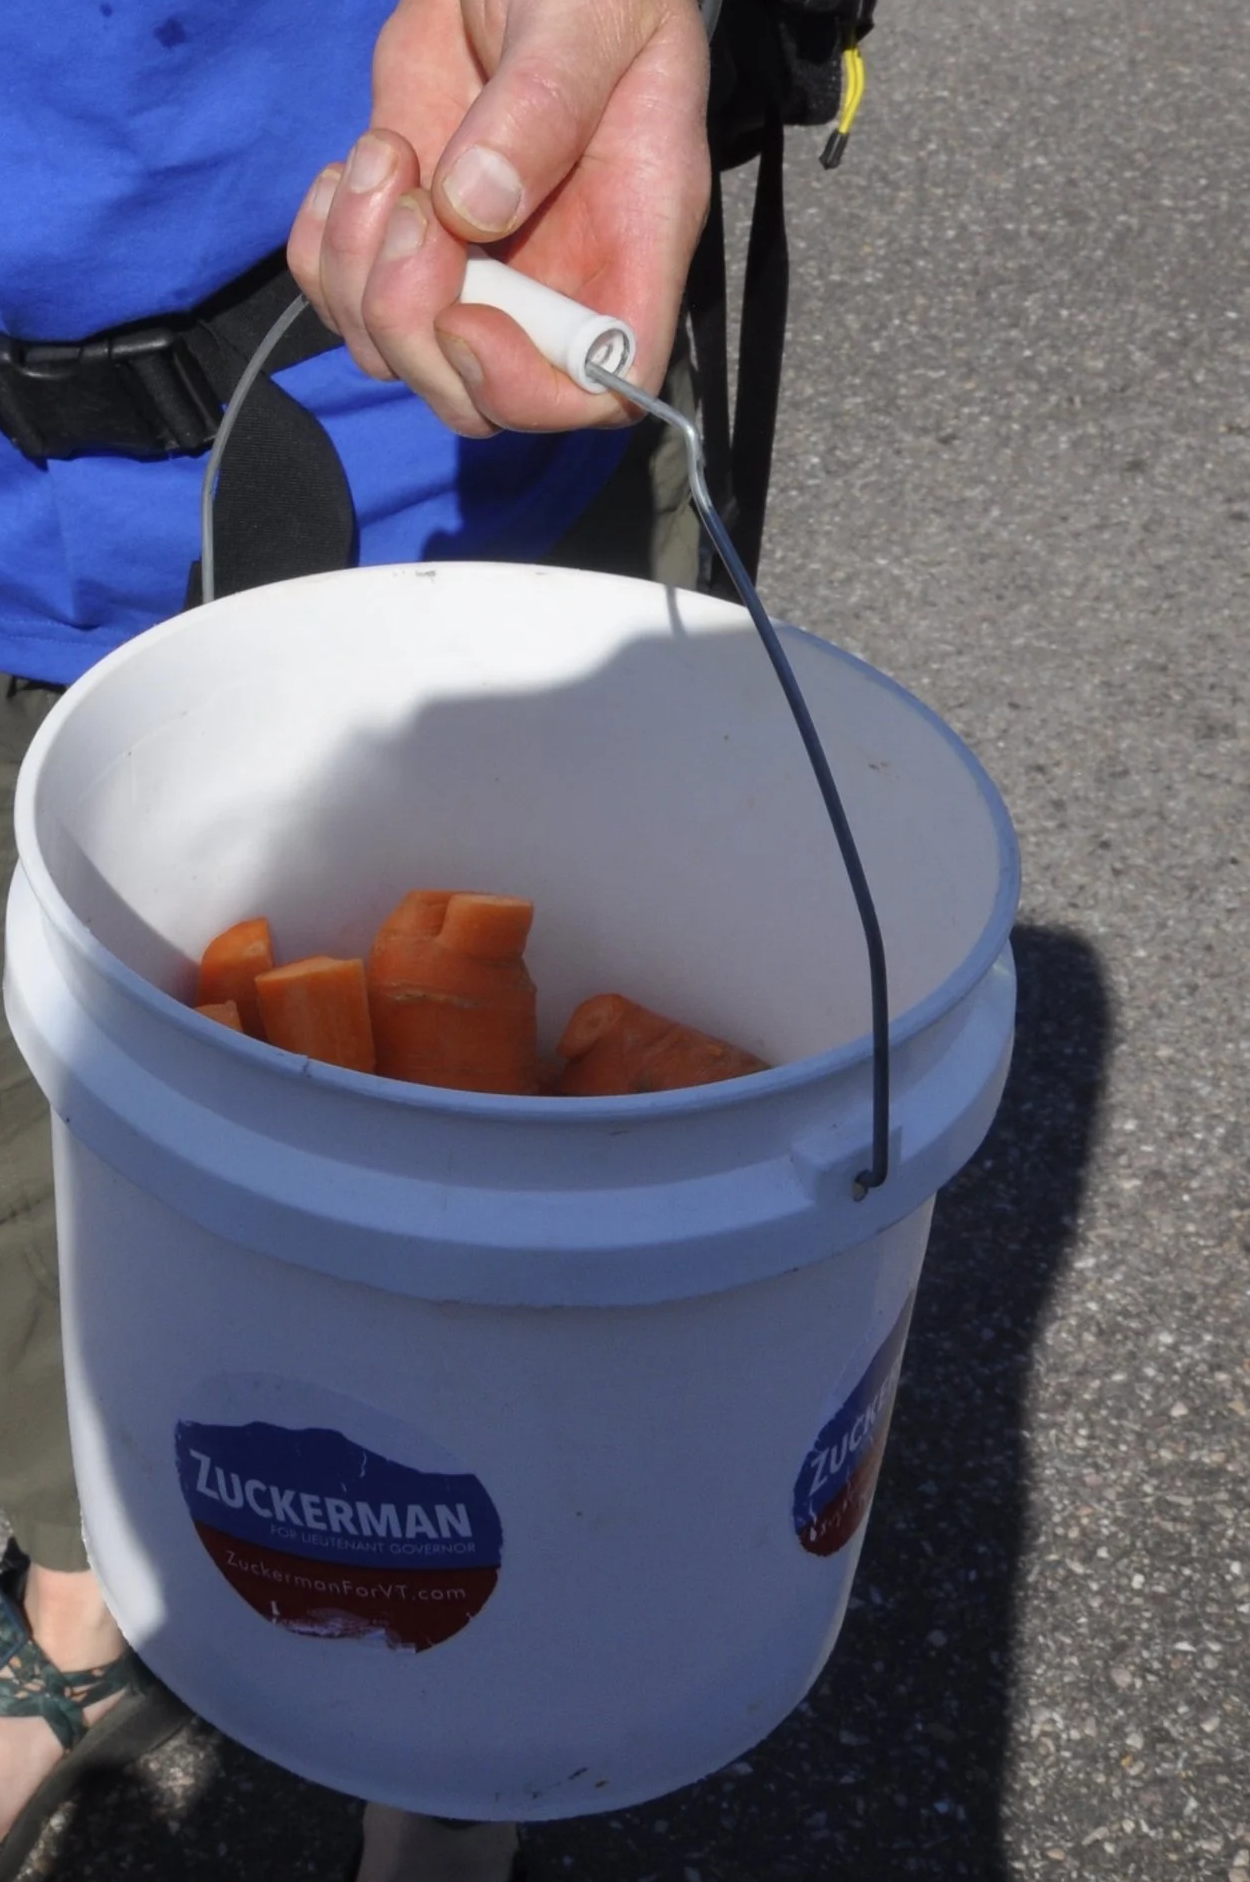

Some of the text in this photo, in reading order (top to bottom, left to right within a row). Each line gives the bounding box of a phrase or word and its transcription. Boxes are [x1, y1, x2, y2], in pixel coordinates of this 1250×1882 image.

[189, 1448, 473, 1539] ZUCKERMAN
[270, 1523, 477, 1555] FOR LIEUTENANT GOVERNOR
[226, 1550, 467, 1602] ZuckermanForVT.com
